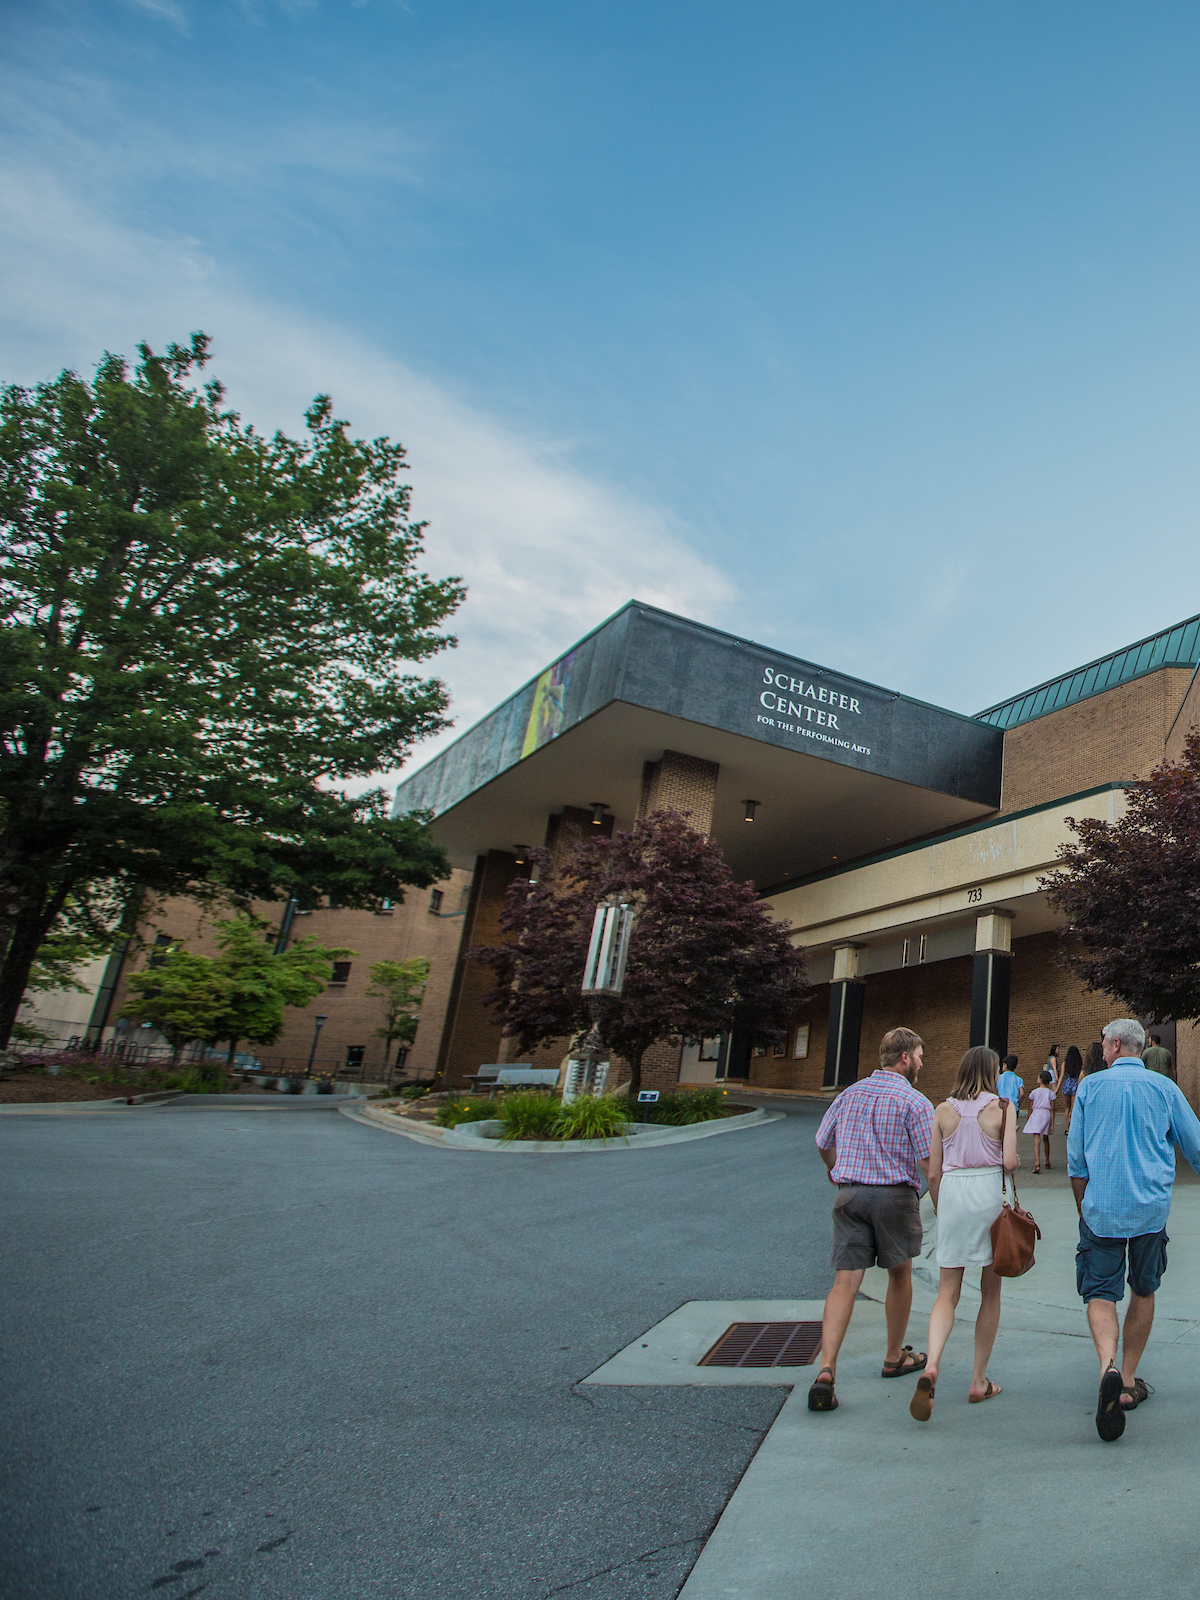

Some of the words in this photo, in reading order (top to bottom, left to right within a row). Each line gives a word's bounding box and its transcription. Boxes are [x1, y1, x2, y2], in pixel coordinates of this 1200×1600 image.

[760, 691, 840, 731] CENTER
[762, 667, 862, 715] SCHAEFER
[757, 714, 775, 727] FOR
[776, 720, 795, 732] THE
[796, 726, 850, 749] PERFORMING
[850, 743, 871, 756] ARTS
[967, 887, 983, 903] 733
